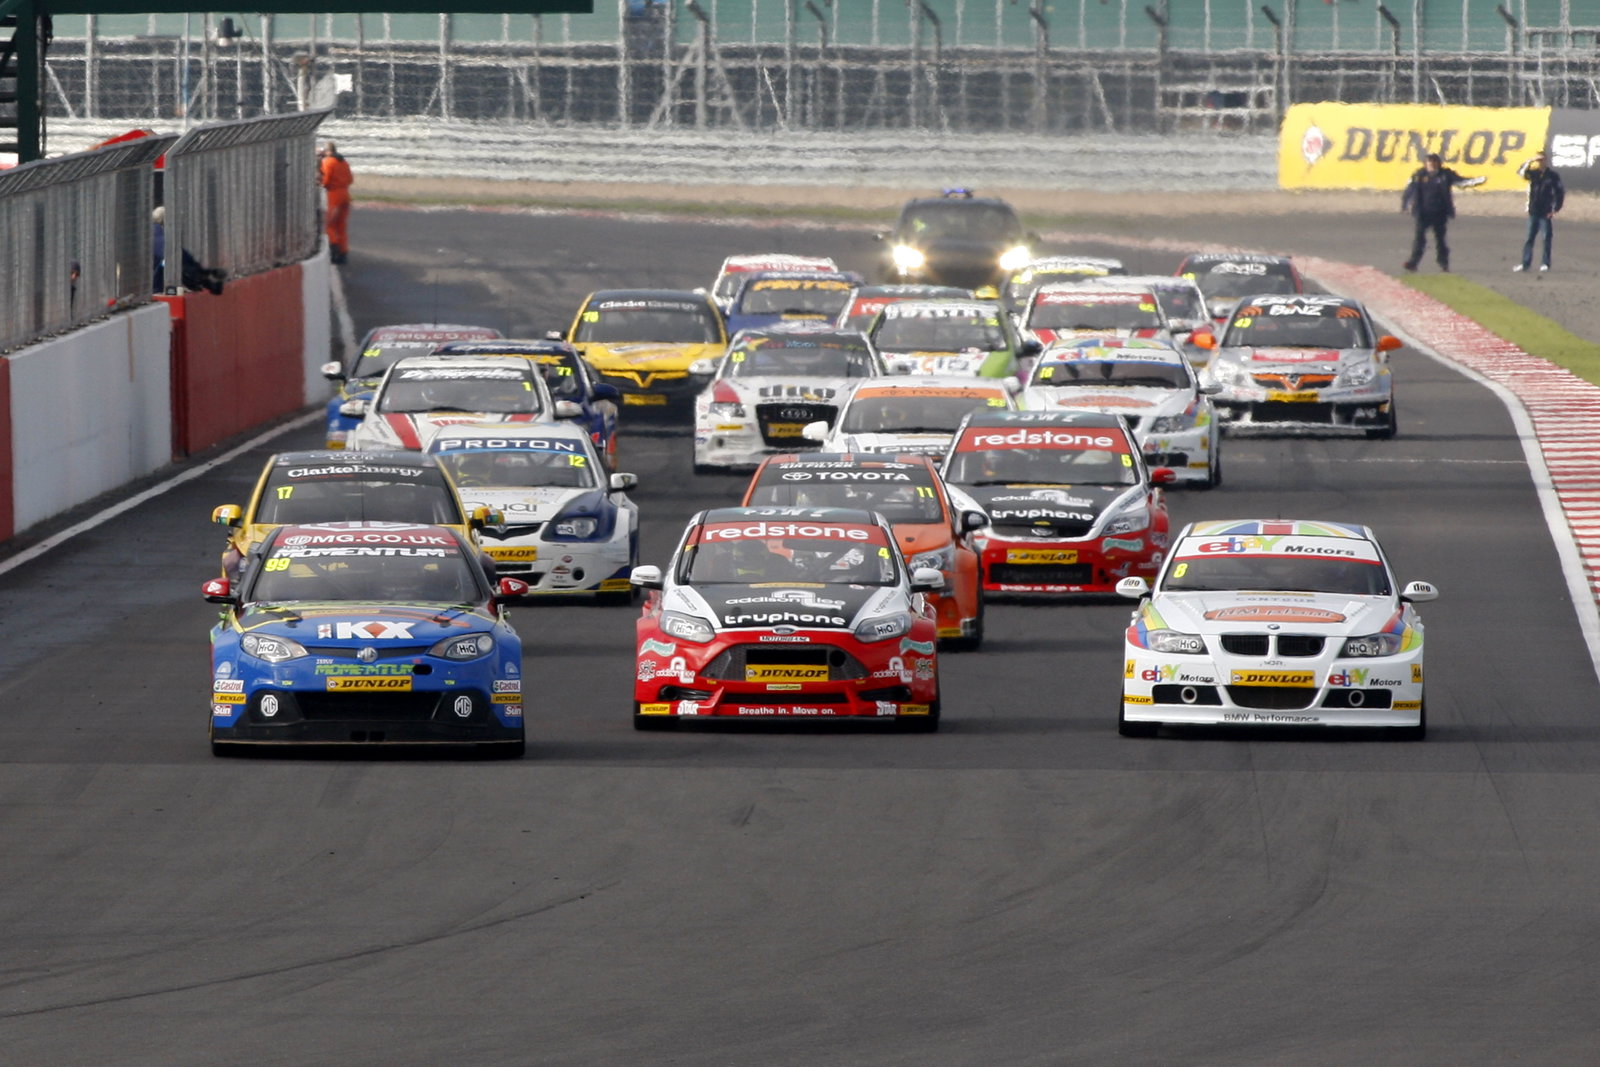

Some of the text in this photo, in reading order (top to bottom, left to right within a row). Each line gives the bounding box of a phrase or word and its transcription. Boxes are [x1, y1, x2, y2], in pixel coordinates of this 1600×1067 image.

[1339, 127, 1525, 166] DUNLOP
[974, 430, 1114, 447] redstone
[440, 439, 575, 452] PROTON
[568, 454, 586, 468] 12
[815, 472, 911, 481] TOYOTA
[276, 486, 294, 500] 17
[916, 486, 935, 499] 11
[991, 508, 1095, 521] truphone
[705, 522, 870, 541] redstone
[312, 533, 448, 546] MG.CO.UK
[273, 547, 446, 559] MOMENTUM
[877, 547, 890, 560] 4
[1284, 545, 1356, 557] Motors
[265, 557, 291, 572] 99
[1173, 563, 1188, 579] 8
[724, 611, 847, 625] truphone
[259, 642, 276, 654] HiQ
[458, 643, 477, 654] HiQ
[1179, 639, 1200, 650] HiQ
[1349, 644, 1368, 653] HiQ
[761, 669, 828, 678] DUNLOP
[1179, 674, 1215, 683] Motors
[1246, 674, 1314, 683] DUNLOP
[220, 680, 242, 691] Castrol
[340, 679, 411, 688] DUNLOP
[499, 680, 520, 691] Castrol
[1369, 678, 1403, 686] Motors
[738, 706, 836, 715] Breathe in. Move on.
[1224, 713, 1320, 723] BMW Performance
